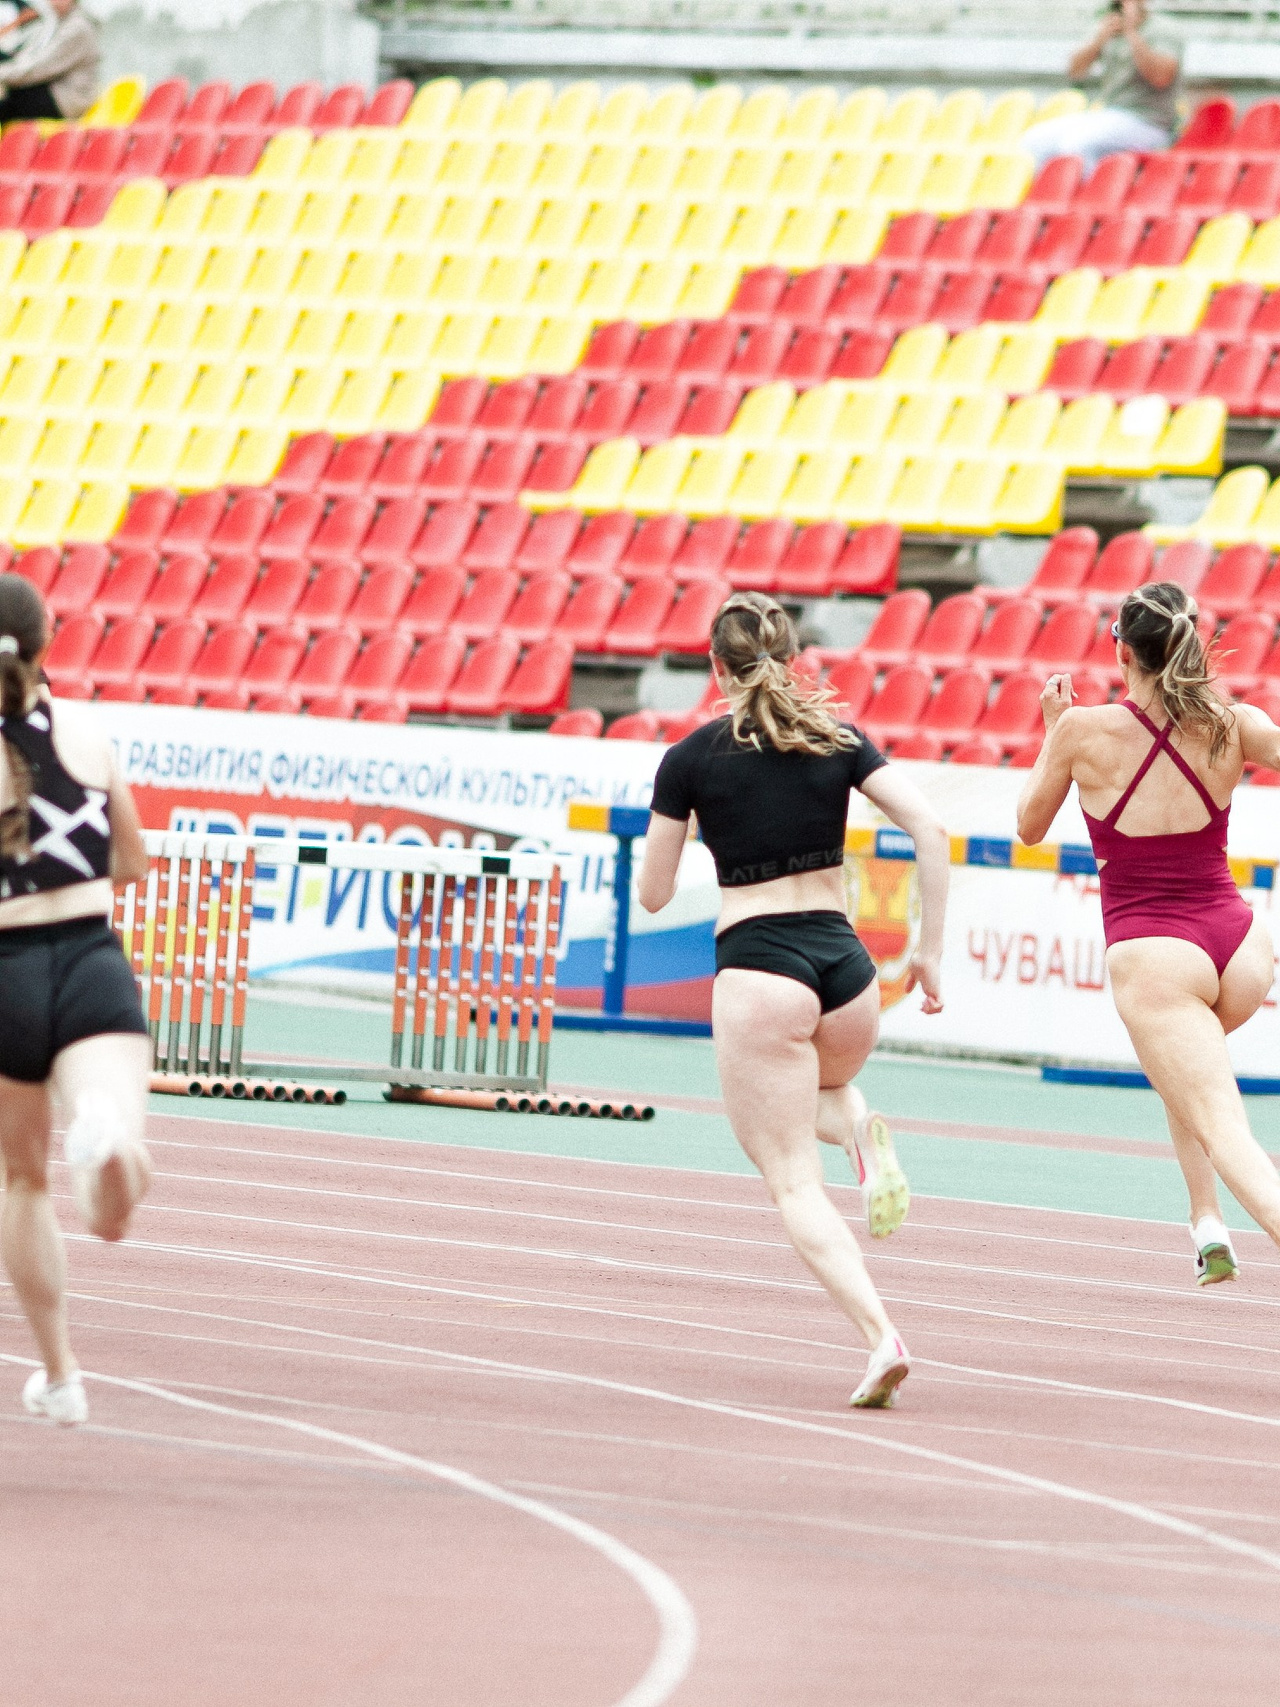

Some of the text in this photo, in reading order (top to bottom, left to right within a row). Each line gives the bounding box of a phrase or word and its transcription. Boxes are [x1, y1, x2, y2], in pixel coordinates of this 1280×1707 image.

[127, 739, 263, 783] РАЗВИТИЯ
[269, 752, 452, 798] ФИЗИЧЕСКОЙ
[459, 766, 603, 808] КУЛЬТУРЫ
[967, 929, 1105, 990] ЧУВАШ
